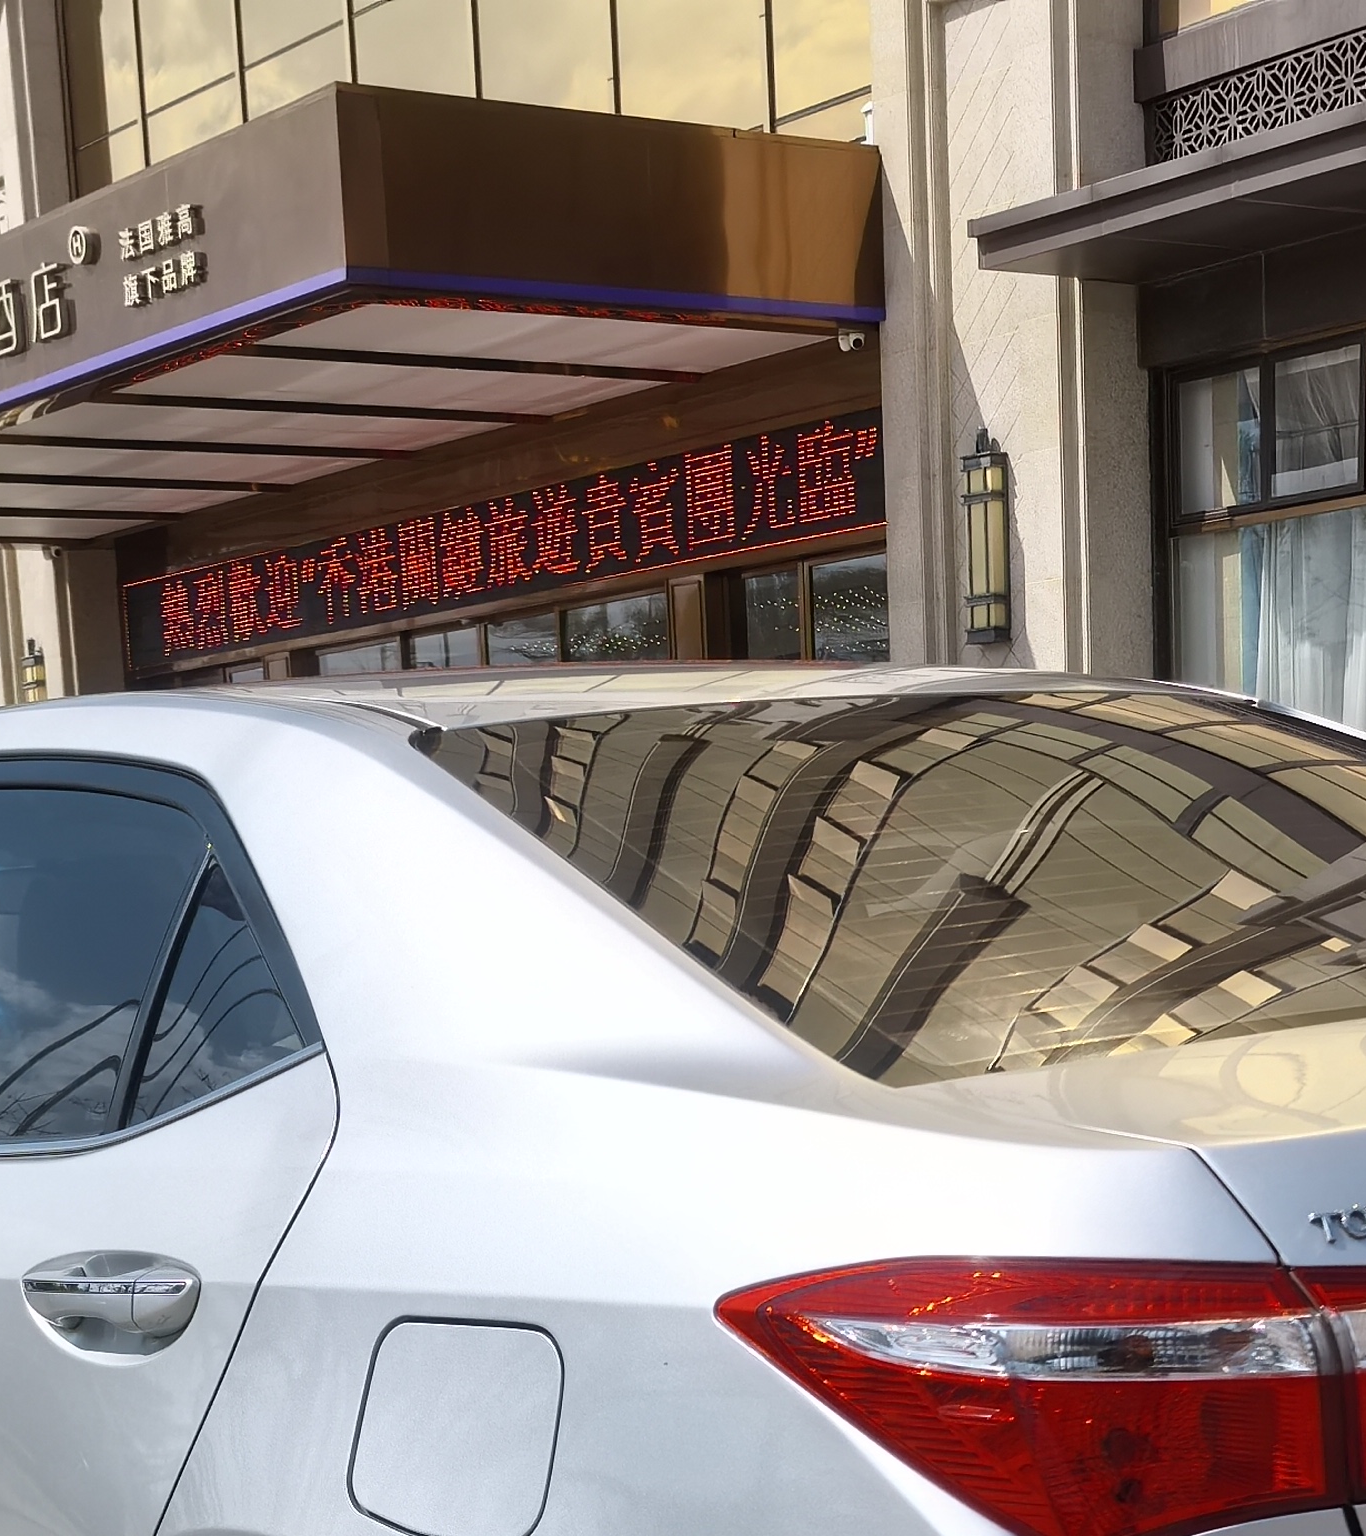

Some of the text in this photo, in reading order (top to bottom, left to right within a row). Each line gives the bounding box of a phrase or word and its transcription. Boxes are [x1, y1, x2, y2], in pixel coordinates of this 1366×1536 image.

[118, 204, 193, 261] 法国雅高
[123, 250, 197, 306] 旗下品牌
